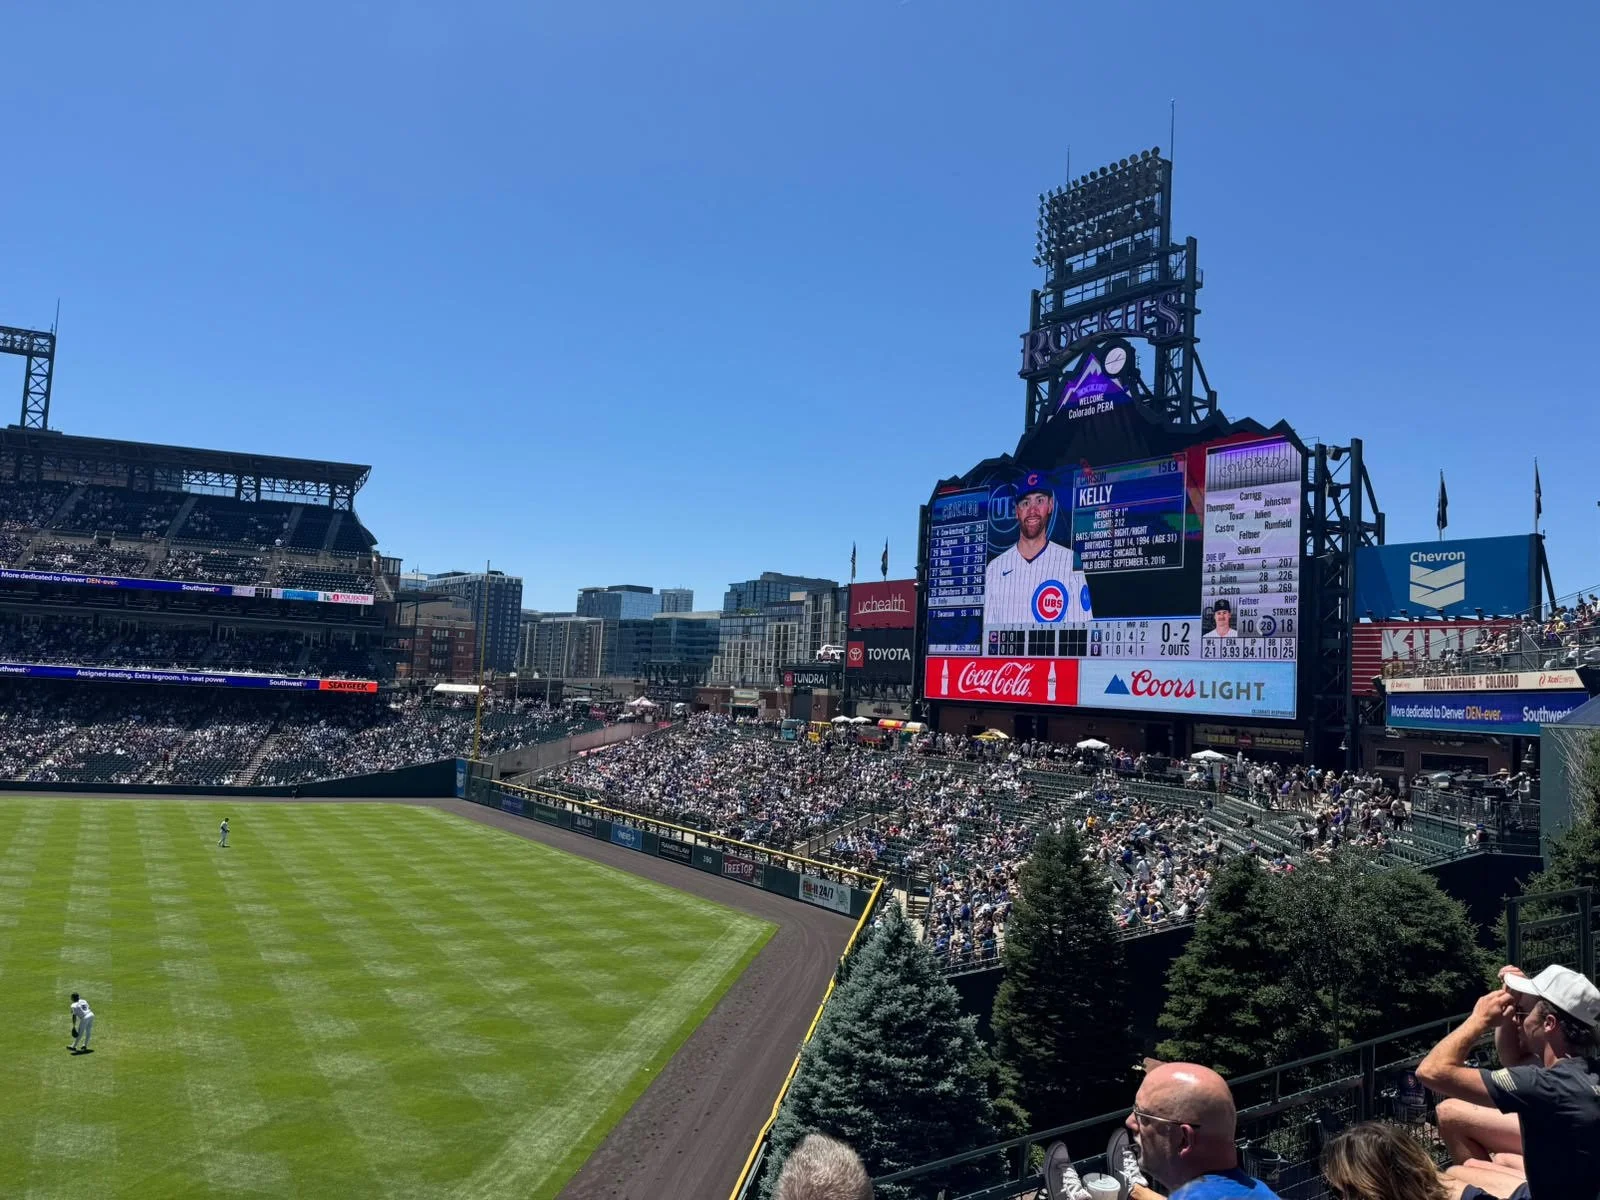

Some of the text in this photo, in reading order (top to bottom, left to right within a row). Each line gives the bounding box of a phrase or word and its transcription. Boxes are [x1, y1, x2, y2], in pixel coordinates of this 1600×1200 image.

[1019, 292, 1182, 373] ROCKIES
[1080, 393, 1104, 406] WELCOME
[1069, 400, 1114, 419] Colorado PERA
[1219, 456, 1289, 478] COLORADO
[1079, 485, 1113, 507] KELLY
[1240, 491, 1262, 501] Carrigg
[1264, 497, 1292, 507] Johnston
[1094, 509, 1114, 519] HEIGHT:
[1206, 503, 1235, 513] Thompson
[1229, 511, 1246, 521] Tovar
[1254, 510, 1272, 520] Julien
[1093, 519, 1114, 529] WEIGHT:
[1215, 524, 1235, 533] Castro
[1264, 519, 1292, 530] Rumfield
[1075, 526, 1148, 541] BATS/THROWS: RIGHT/RIGHT
[1239, 530, 1261, 540] Feltner
[1113, 539, 1126, 548] JULY
[1152, 534, 1166, 545] (AGE
[1238, 546, 1261, 556] Sullivan
[1409, 550, 1465, 563] Chevron
[1113, 557, 1144, 568] SEPTEMBER
[1151, 555, 1166, 565] 2016
[1207, 564, 1216, 573] 26
[1219, 562, 1245, 571] Sullivan
[1261, 560, 1267, 569] C
[1, 571, 20, 580] More
[20, 572, 53, 582] dedicated
[53, 574, 61, 582] to
[61, 575, 85, 584] Denver
[1211, 576, 1216, 584] 6
[1219, 575, 1237, 584] Julien
[182, 583, 215, 593] Southwest
[1211, 587, 1216, 596] 3
[1219, 586, 1240, 596] Castro
[858, 593, 906, 613] uchealth
[1284, 595, 1298, 605] RHP
[1240, 607, 1297, 617] BALLS STRIKES
[1241, 619, 1293, 633] 10 28 18
[1225, 638, 1237, 646] ERA
[1250, 638, 1257, 646] IP
[867, 648, 911, 662] TOYOTA
[1160, 644, 1190, 656] 2 OUTS
[1204, 647, 1294, 658] 2-1 3.93 34.1 10 25
[76, 669, 107, 679] Assigned
[134, 672, 151, 680] Extra
[182, 675, 205, 683] In-seat
[793, 672, 825, 685] TUNDRA
[957, 661, 1035, 696] Coca-Cola
[1423, 674, 1519, 690] PROUDLY POWERING COLORADO
[269, 679, 302, 687] Southwest
[328, 681, 368, 691] SEATGEEK
[1131, 669, 1264, 701] Coors LIGHT
[1391, 705, 1405, 717] More
[1406, 704, 1434, 718] dedicated
[1434, 706, 1440, 718] to
[1441, 706, 1465, 720] Denver
[818, 884, 834, 900] 24/7
